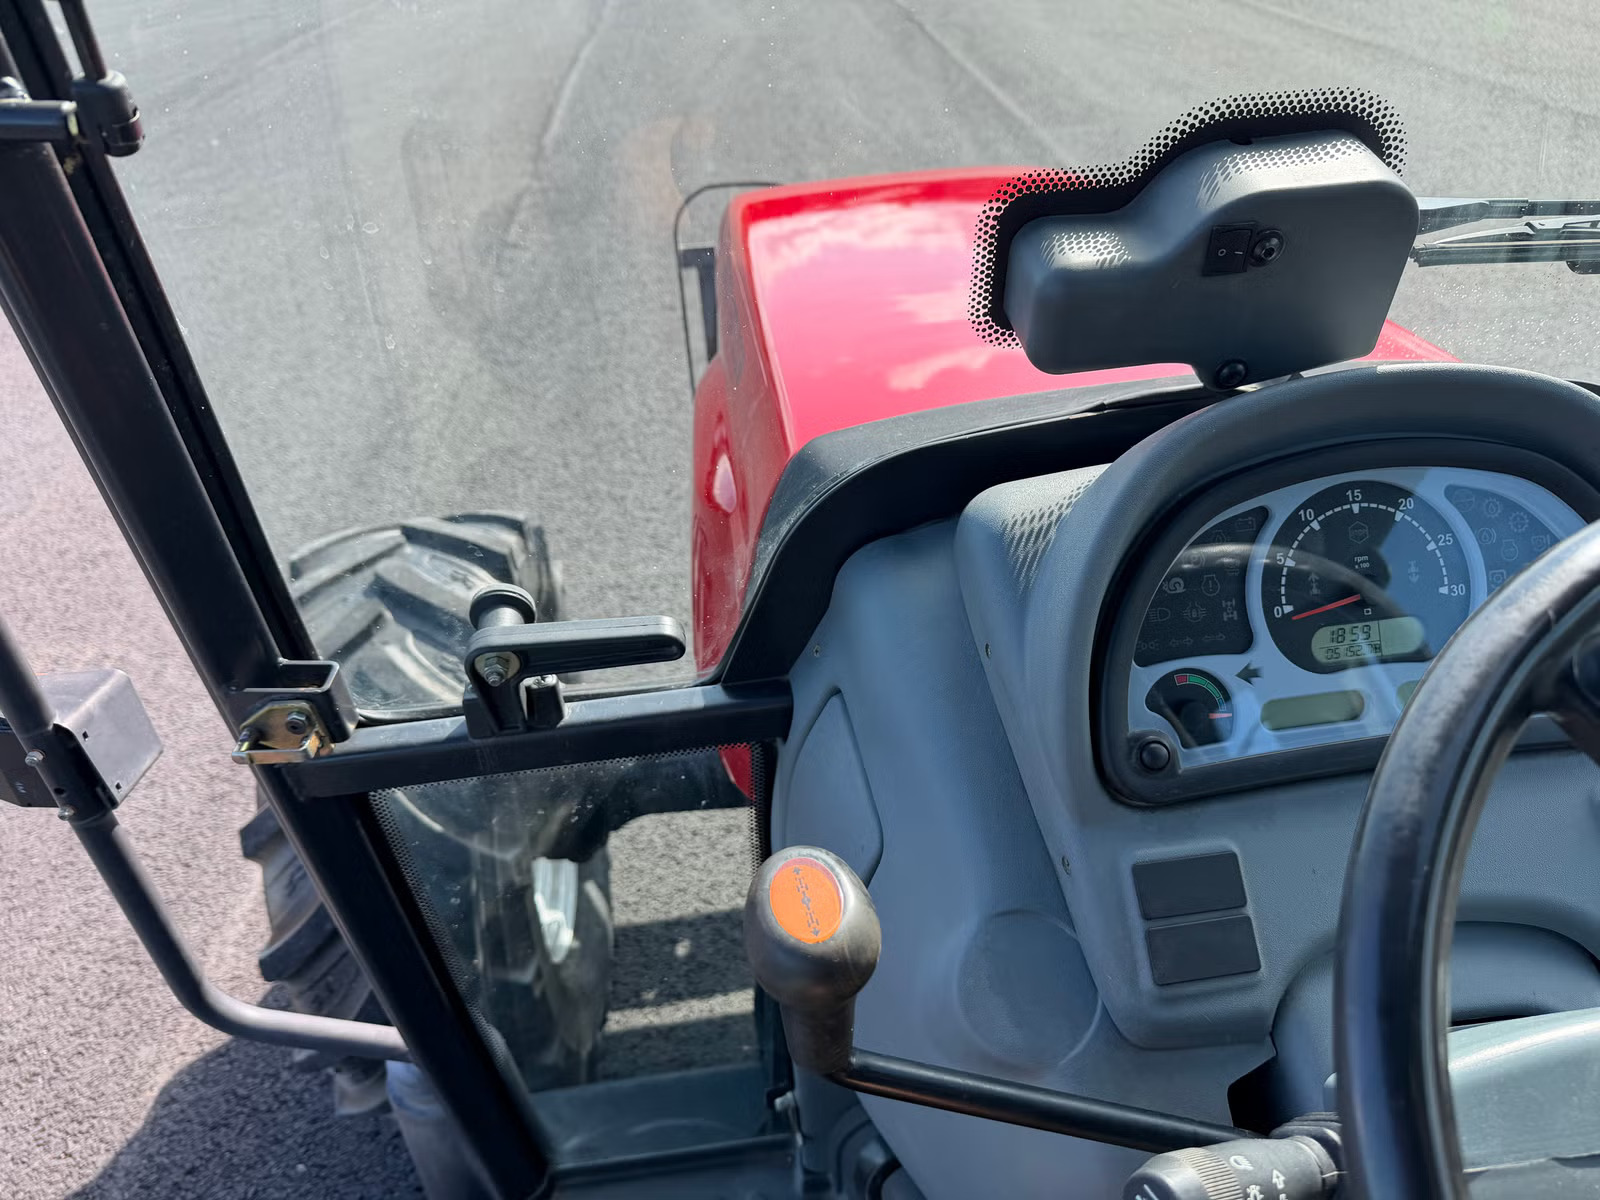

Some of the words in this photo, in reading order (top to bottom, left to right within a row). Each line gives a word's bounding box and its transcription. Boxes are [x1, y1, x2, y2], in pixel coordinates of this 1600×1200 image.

[1346, 489, 1362, 501] 15
[1399, 498, 1414, 511] 20
[1299, 508, 1315, 521] 10
[1438, 534, 1453, 547] 25
[1276, 553, 1285, 565] 5
[1354, 555, 1369, 564] rpm
[1450, 584, 1466, 597] 30
[1273, 606, 1283, 618] 0
